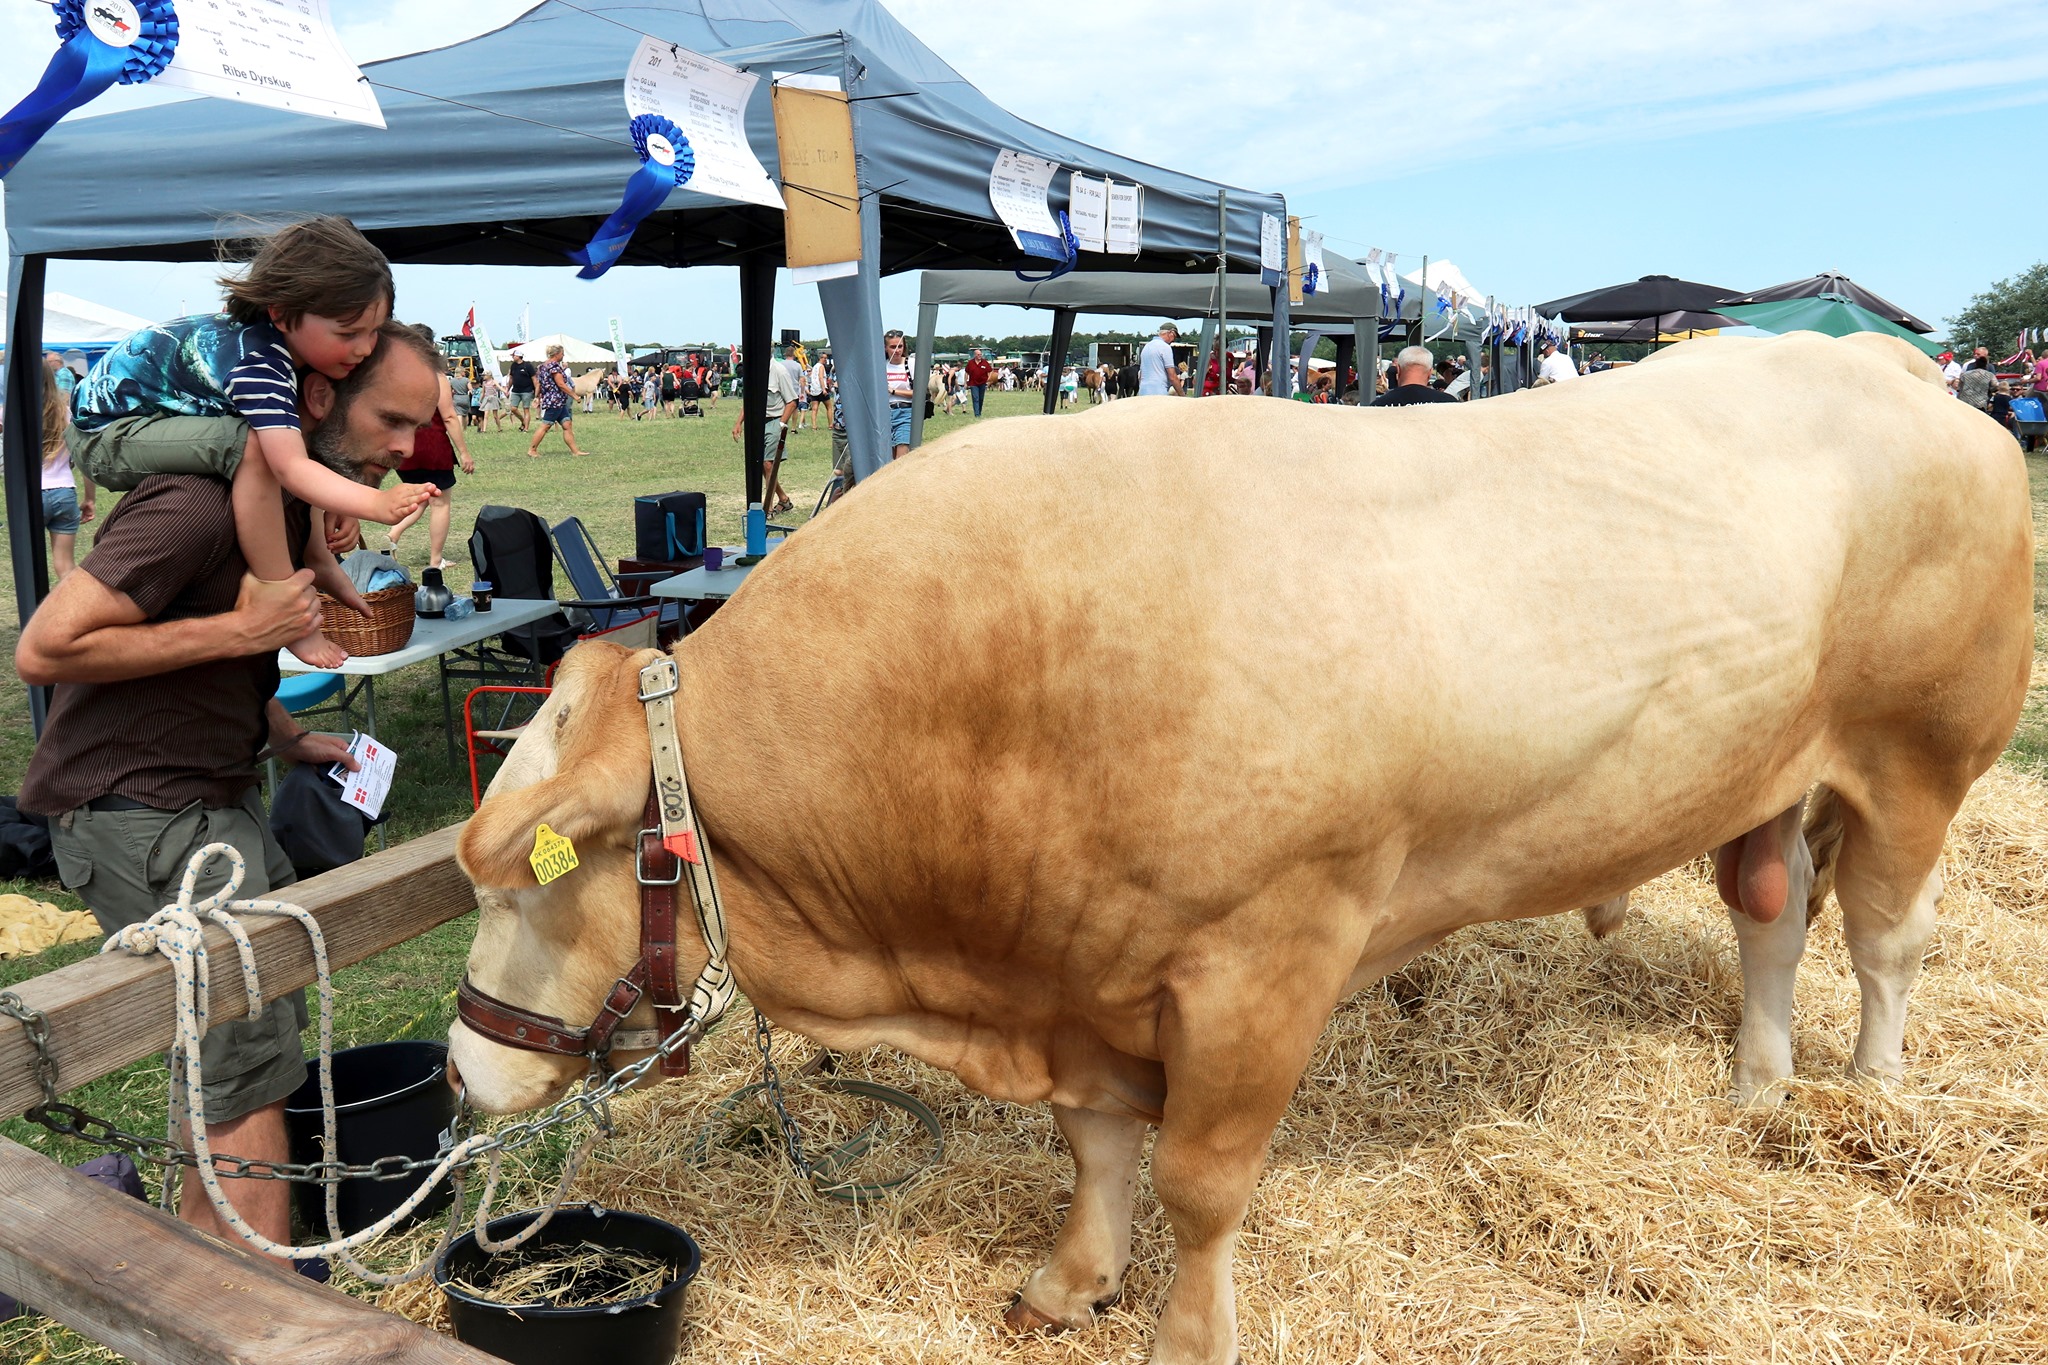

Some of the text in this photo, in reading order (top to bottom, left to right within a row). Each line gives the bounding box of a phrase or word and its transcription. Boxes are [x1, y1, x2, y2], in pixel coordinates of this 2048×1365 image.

[109, 0, 126, 14] 2019
[648, 55, 662, 68] 201
[222, 64, 292, 89] Ribe Dyrskue
[660, 780, 686, 822] 200
[535, 846, 577, 883] 00384
